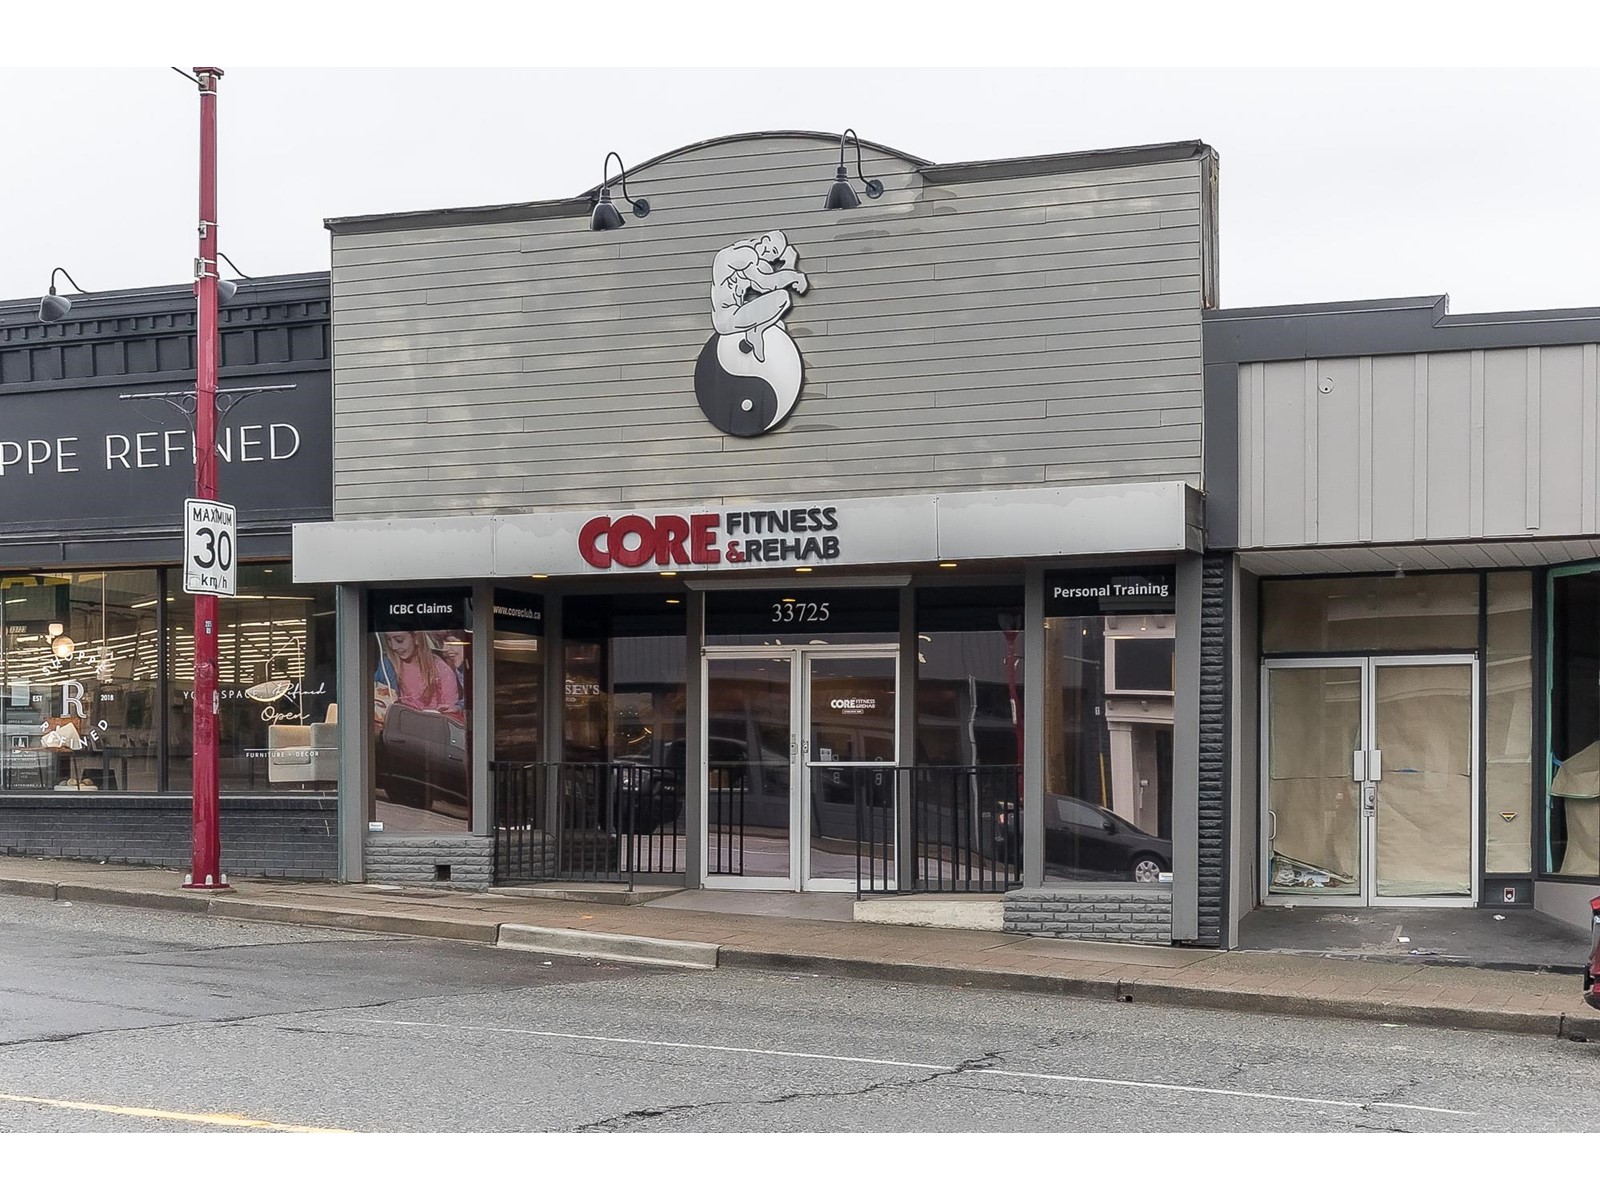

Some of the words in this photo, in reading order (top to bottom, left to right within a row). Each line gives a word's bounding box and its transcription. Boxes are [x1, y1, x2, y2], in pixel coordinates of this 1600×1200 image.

[0, 437, 80, 475] PPE
[106, 423, 301, 470] REFINED
[193, 507, 232, 526] MAXIMUM
[726, 507, 839, 535] FITNESS
[193, 527, 232, 571] 30
[578, 513, 721, 569] CORE
[201, 573, 228, 589] km/h
[1054, 584, 1110, 598] Personal
[1113, 583, 1169, 597] Training
[389, 604, 414, 615] ICBC
[416, 602, 453, 614] Claims
[493, 605, 541, 620] www.coreclub.ca
[771, 602, 830, 622] 33725
[60, 681, 87, 719] R
[100, 694, 115, 702] 2018
[830, 699, 856, 709] CORE
[261, 706, 310, 726] Open
